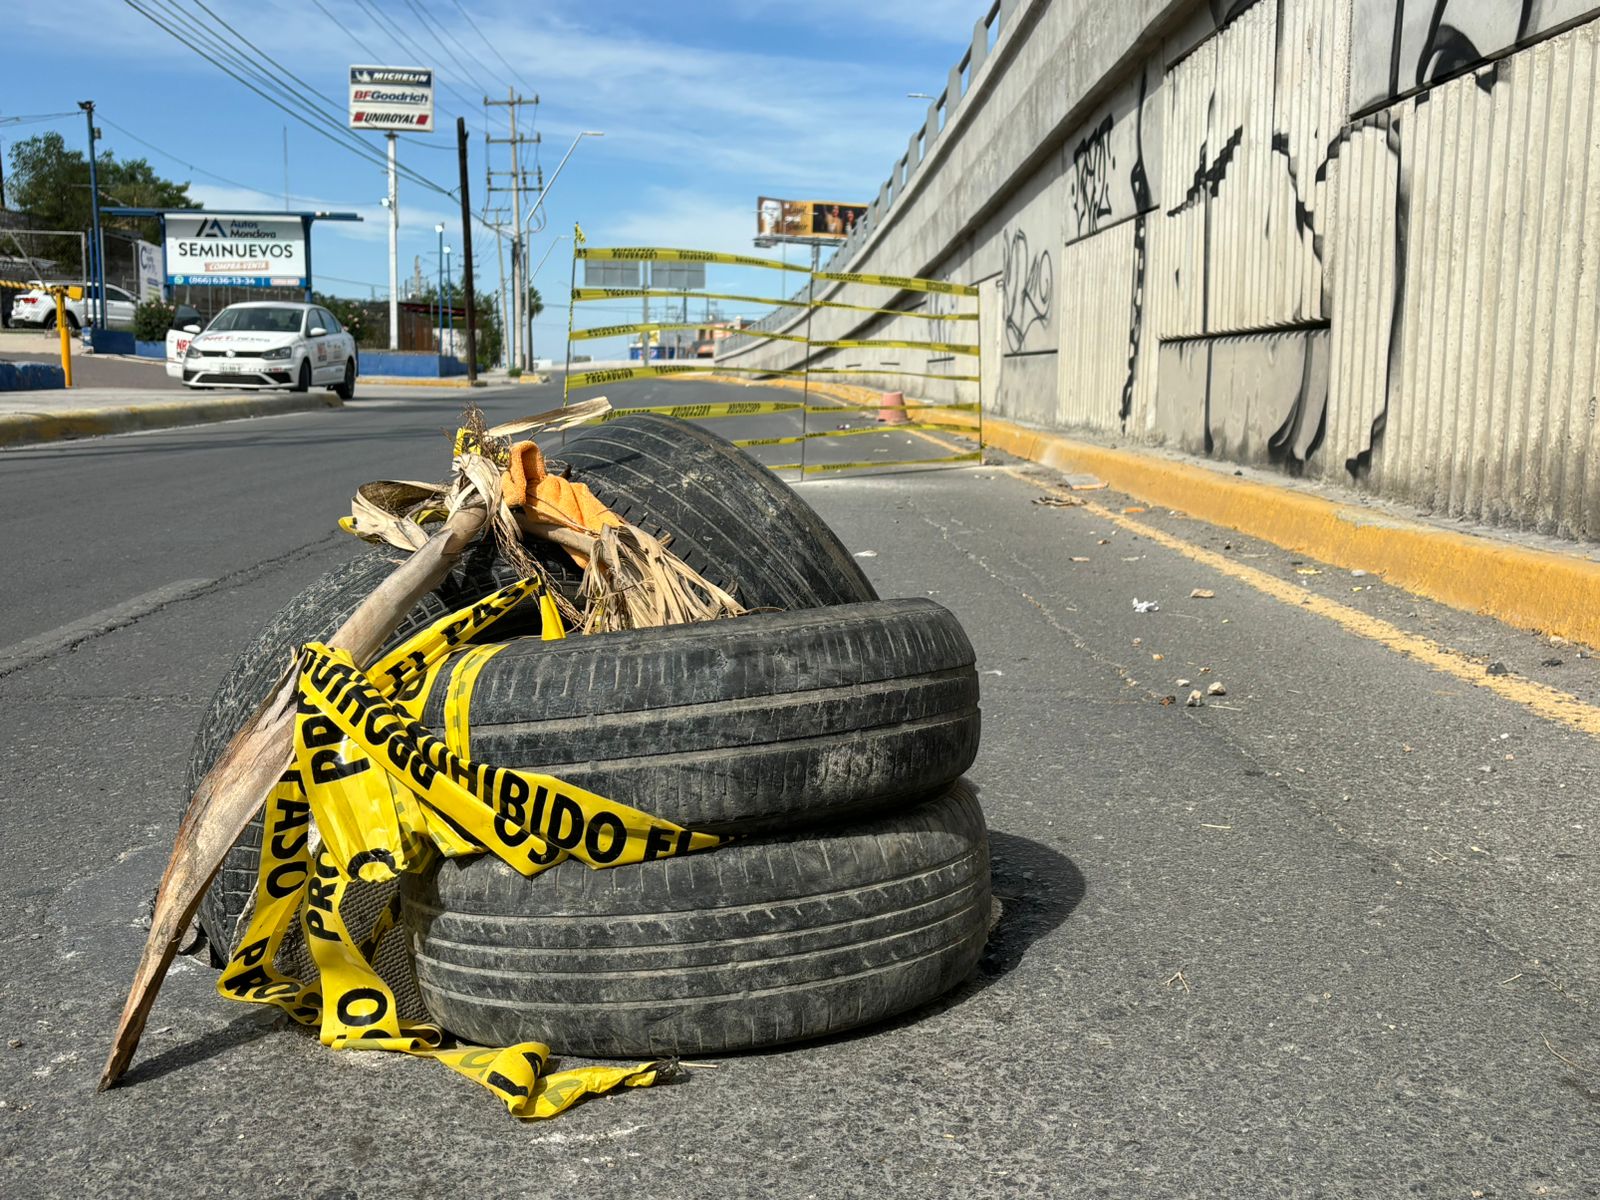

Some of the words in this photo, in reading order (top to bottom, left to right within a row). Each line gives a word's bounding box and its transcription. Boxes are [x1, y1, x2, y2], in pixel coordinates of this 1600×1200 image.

[372, 72, 428, 82] MICHELIN
[353, 90, 429, 103] BFGoodrich
[364, 112, 416, 124] UNIROYAL
[230, 219, 258, 229] Autos
[178, 242, 293, 258] SEMINUEVOS
